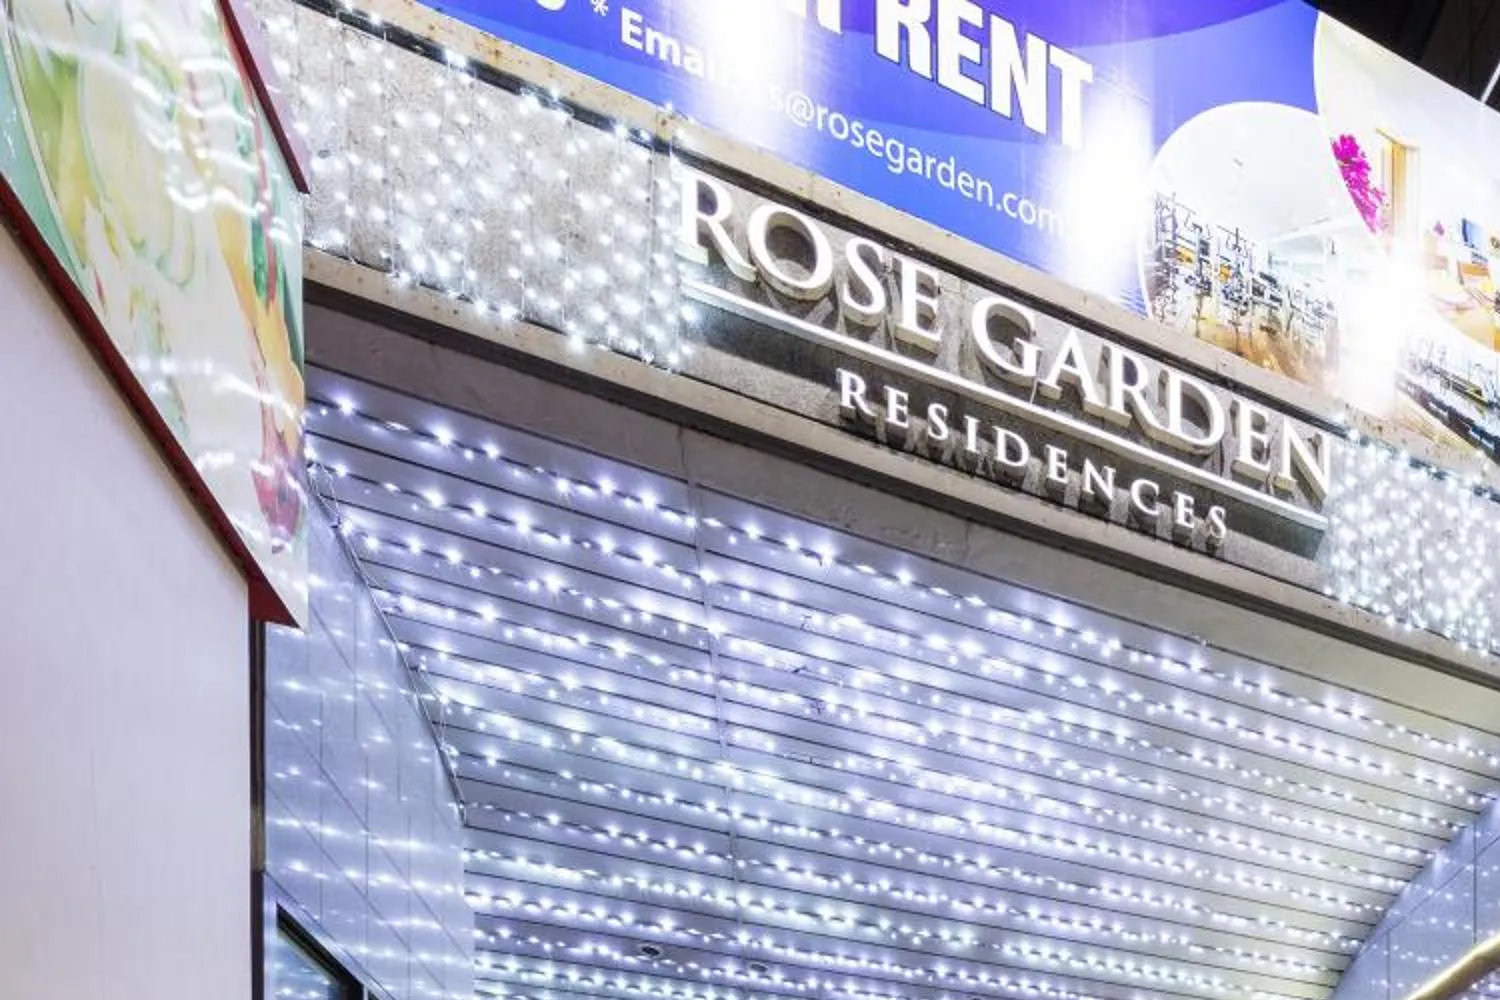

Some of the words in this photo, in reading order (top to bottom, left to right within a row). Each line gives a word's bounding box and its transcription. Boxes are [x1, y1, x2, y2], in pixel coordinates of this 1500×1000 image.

[873, 0, 1094, 151] RENT
[672, 157, 950, 345] ROSE
[970, 298, 1332, 500] GARDEN
[836, 368, 1229, 542] RESIDENCES
